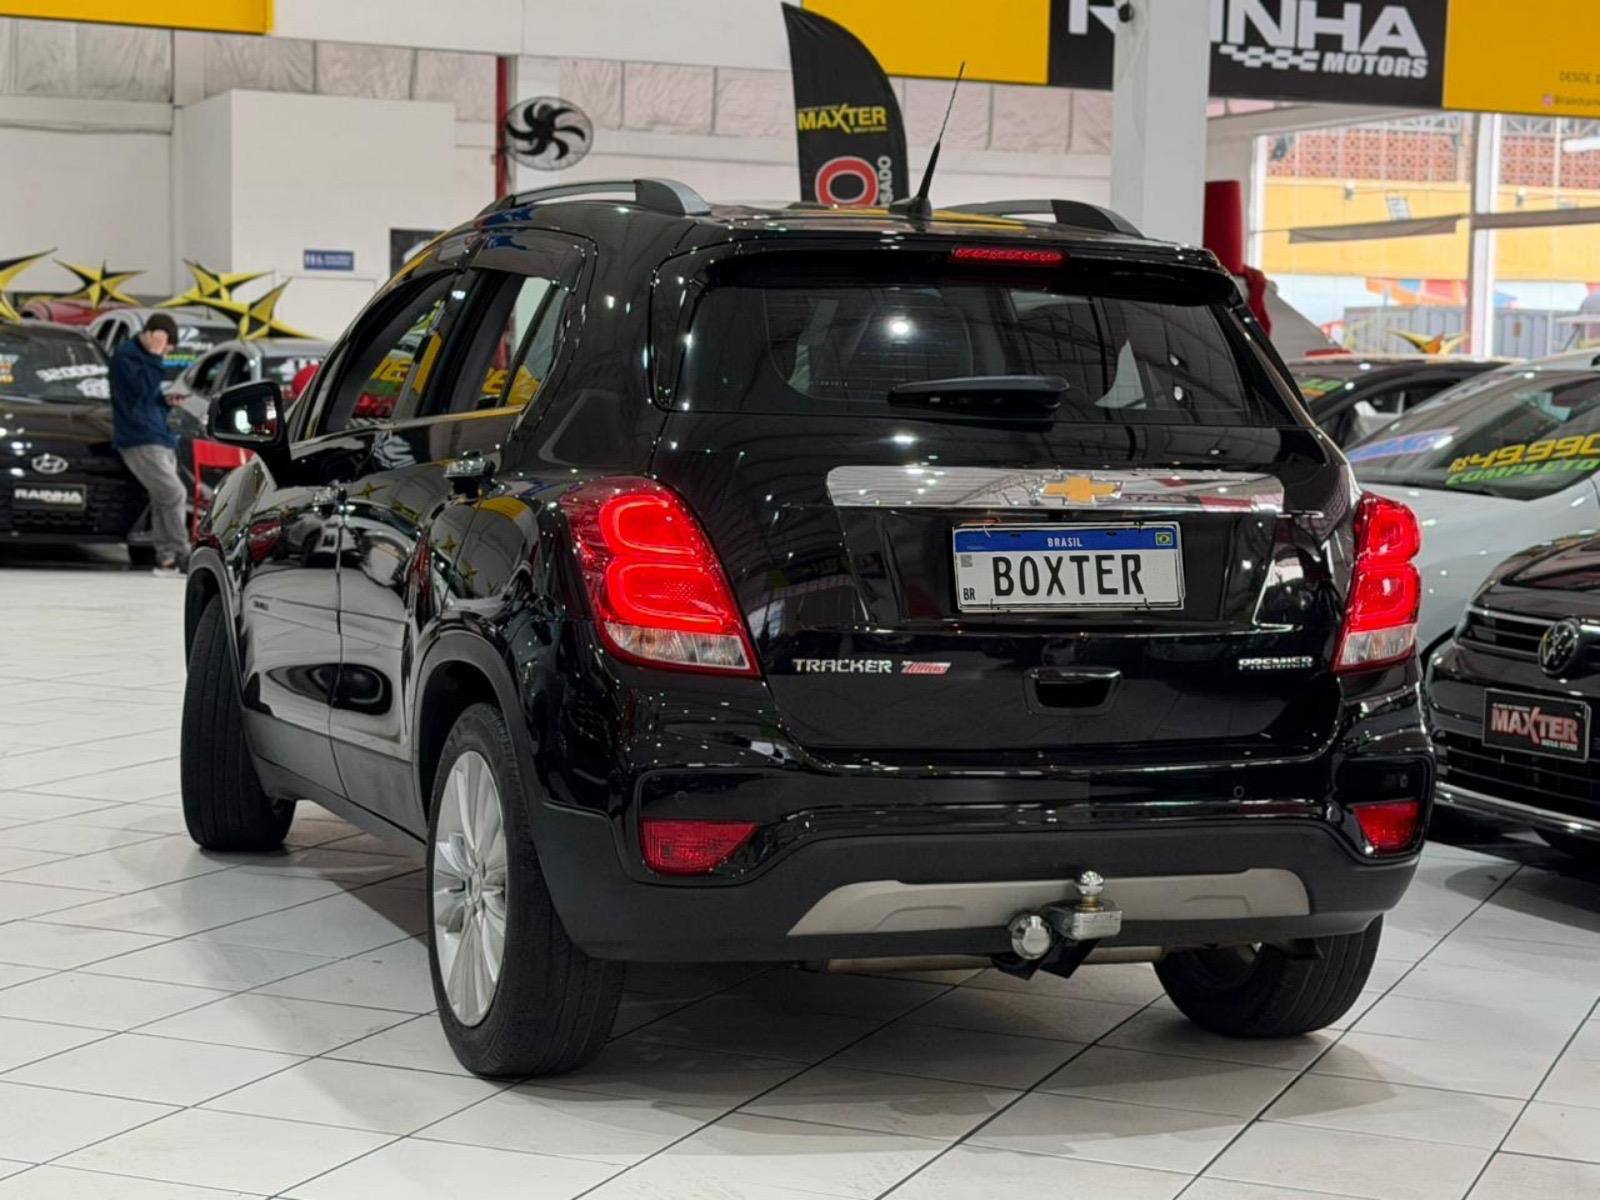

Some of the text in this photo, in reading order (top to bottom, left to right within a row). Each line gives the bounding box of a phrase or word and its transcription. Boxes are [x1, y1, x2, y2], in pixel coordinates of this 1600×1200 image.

[1322, 51, 1429, 79] MOTORS
[797, 104, 887, 134] MAXTER
[877, 155, 893, 208] SADO
[1445, 458, 1600, 487] COMPLETO
[1047, 536, 1083, 548] BRASIL
[991, 553, 1145, 597] BOXTER
[963, 587, 976, 601] BR
[793, 658, 893, 674] TRACKER
[1238, 655, 1313, 670] PREMIER
[1490, 706, 1579, 745] MAXTER
